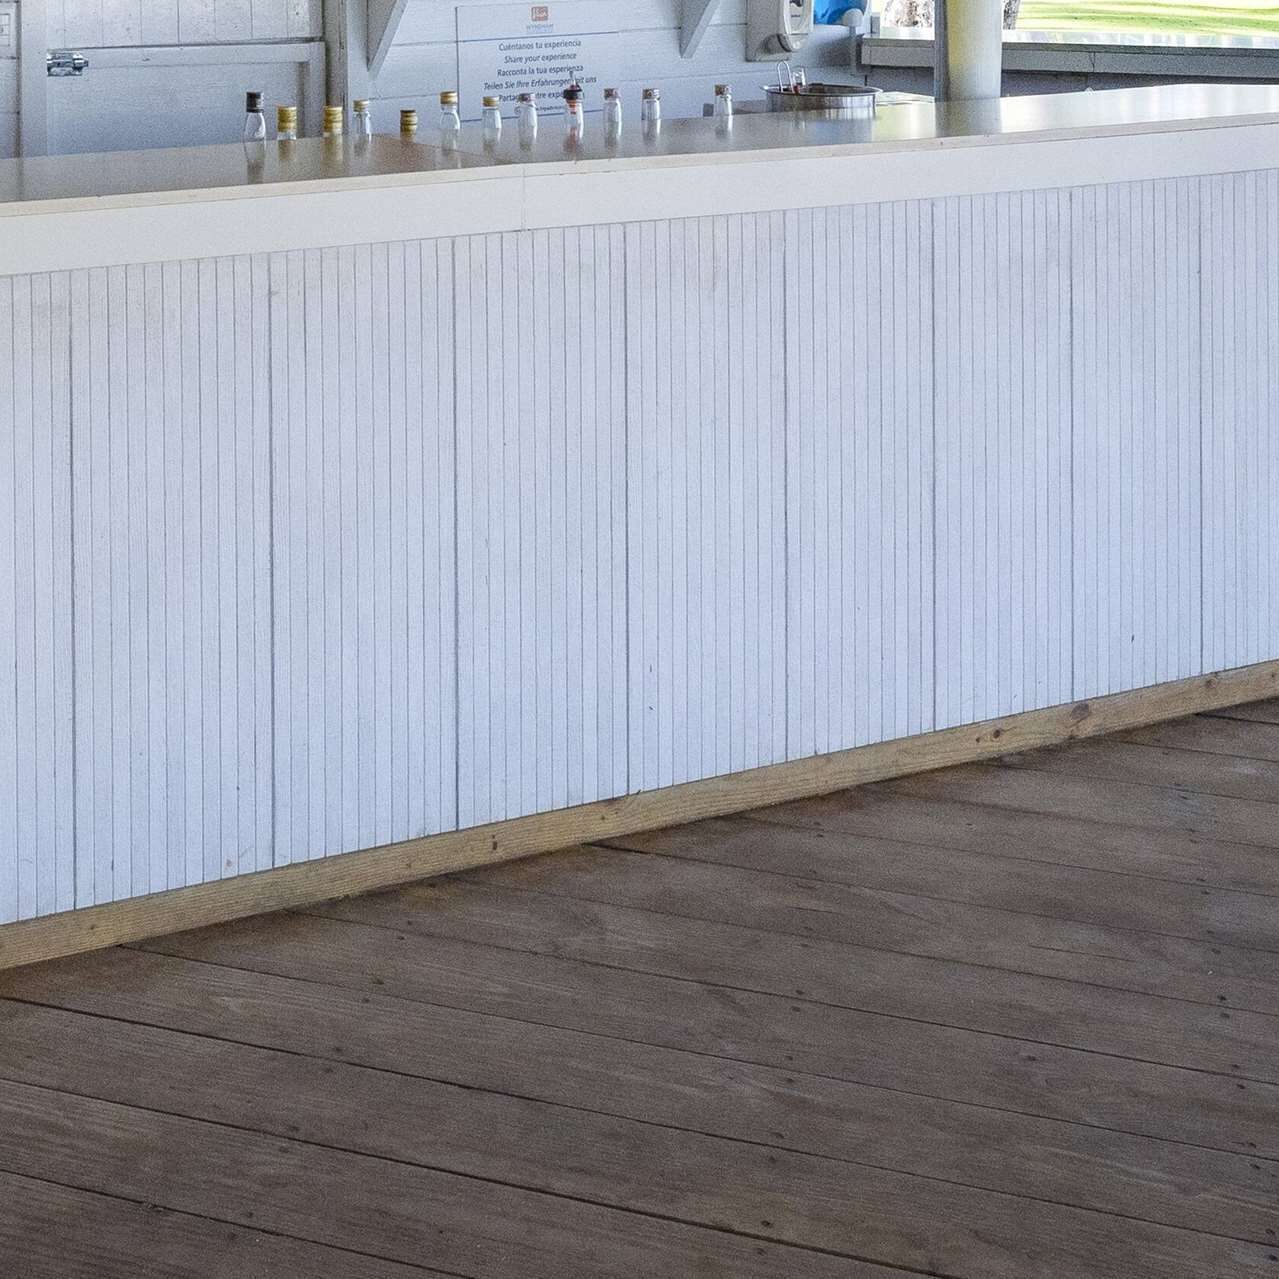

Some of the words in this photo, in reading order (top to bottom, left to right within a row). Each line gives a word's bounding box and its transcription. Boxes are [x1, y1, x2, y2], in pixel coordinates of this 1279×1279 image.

[499, 42, 534, 52] Cuéntanos
[544, 40, 582, 50] experiencia
[504, 55, 524, 64] Share
[524, 56, 540, 64] your
[541, 53, 577, 62] experience
[497, 68, 527, 77] Racconta
[528, 67, 535, 75] la
[536, 66, 547, 74] tua
[548, 65, 584, 75] esperienza
[483, 82, 503, 91] Teilen
[504, 81, 514, 90] Sie
[516, 80, 529, 88] Ihre
